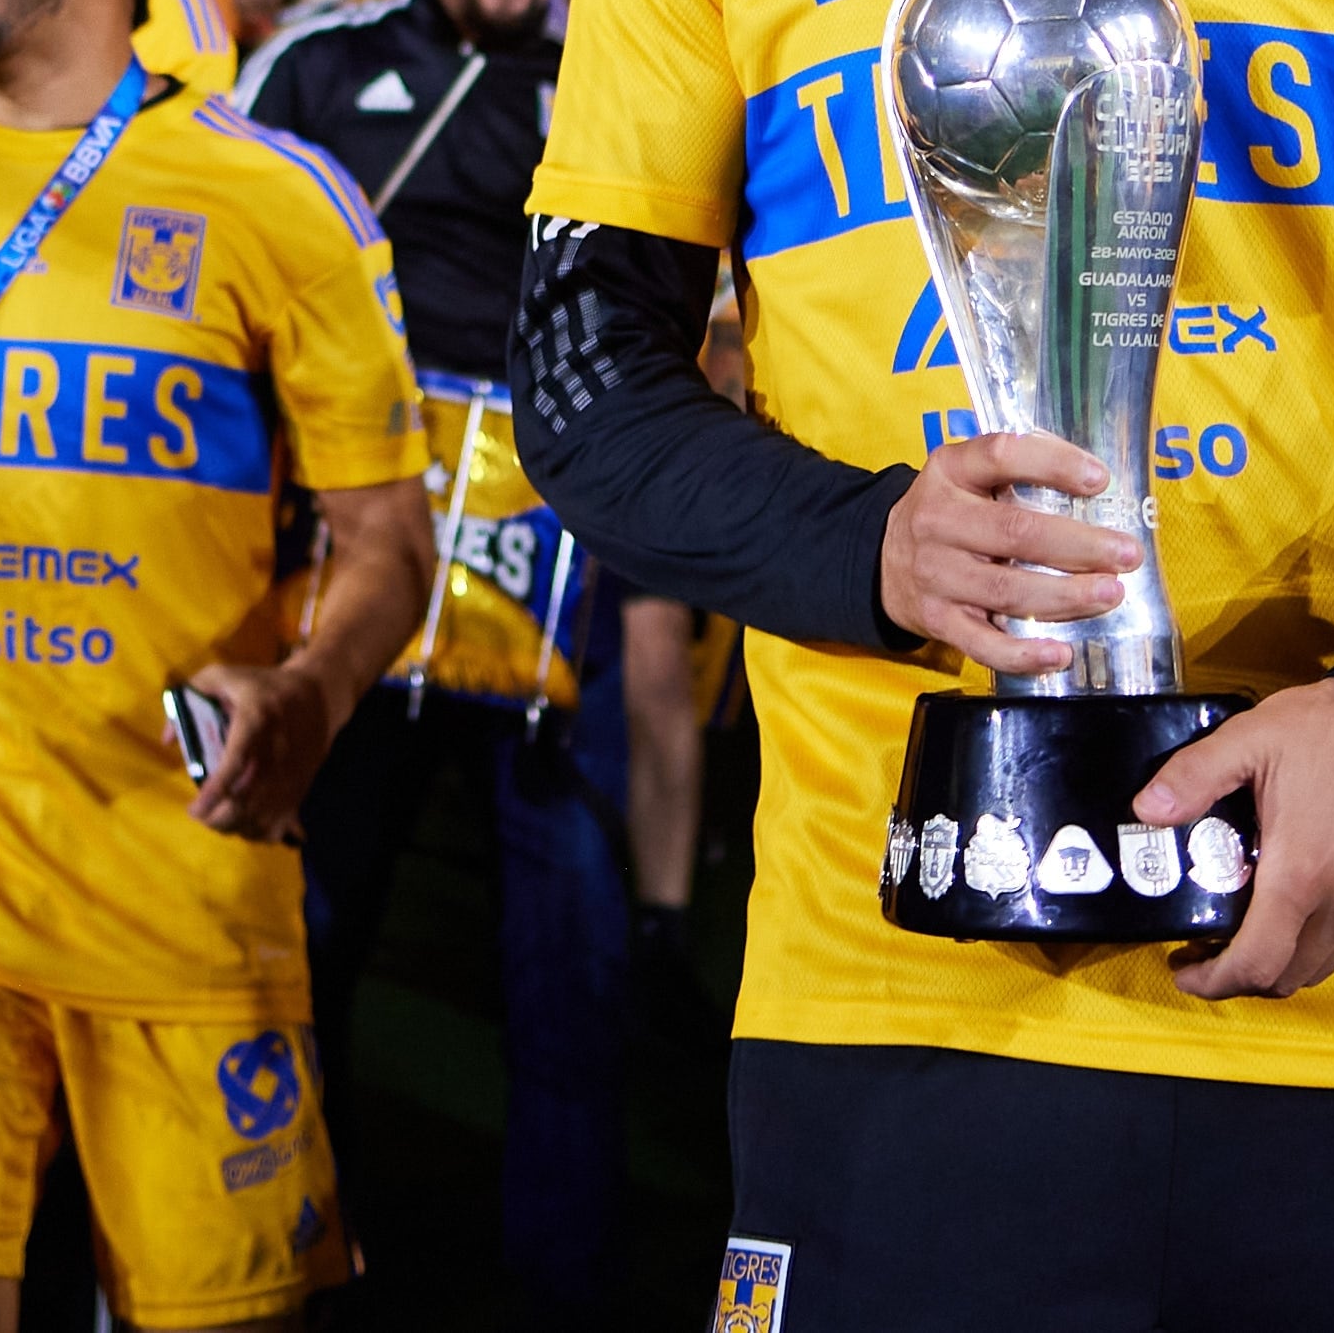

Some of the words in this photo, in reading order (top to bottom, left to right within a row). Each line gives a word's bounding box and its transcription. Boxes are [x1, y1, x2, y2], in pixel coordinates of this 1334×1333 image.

[63, 114, 122, 185] BBVA
[1113, 210, 1173, 226] ESTADIO
[1117, 225, 1168, 241] AKRON
[1126, 292, 1147, 308] VS
[1091, 312, 1147, 328] TIGRES
[1092, 332, 1115, 348] LA
